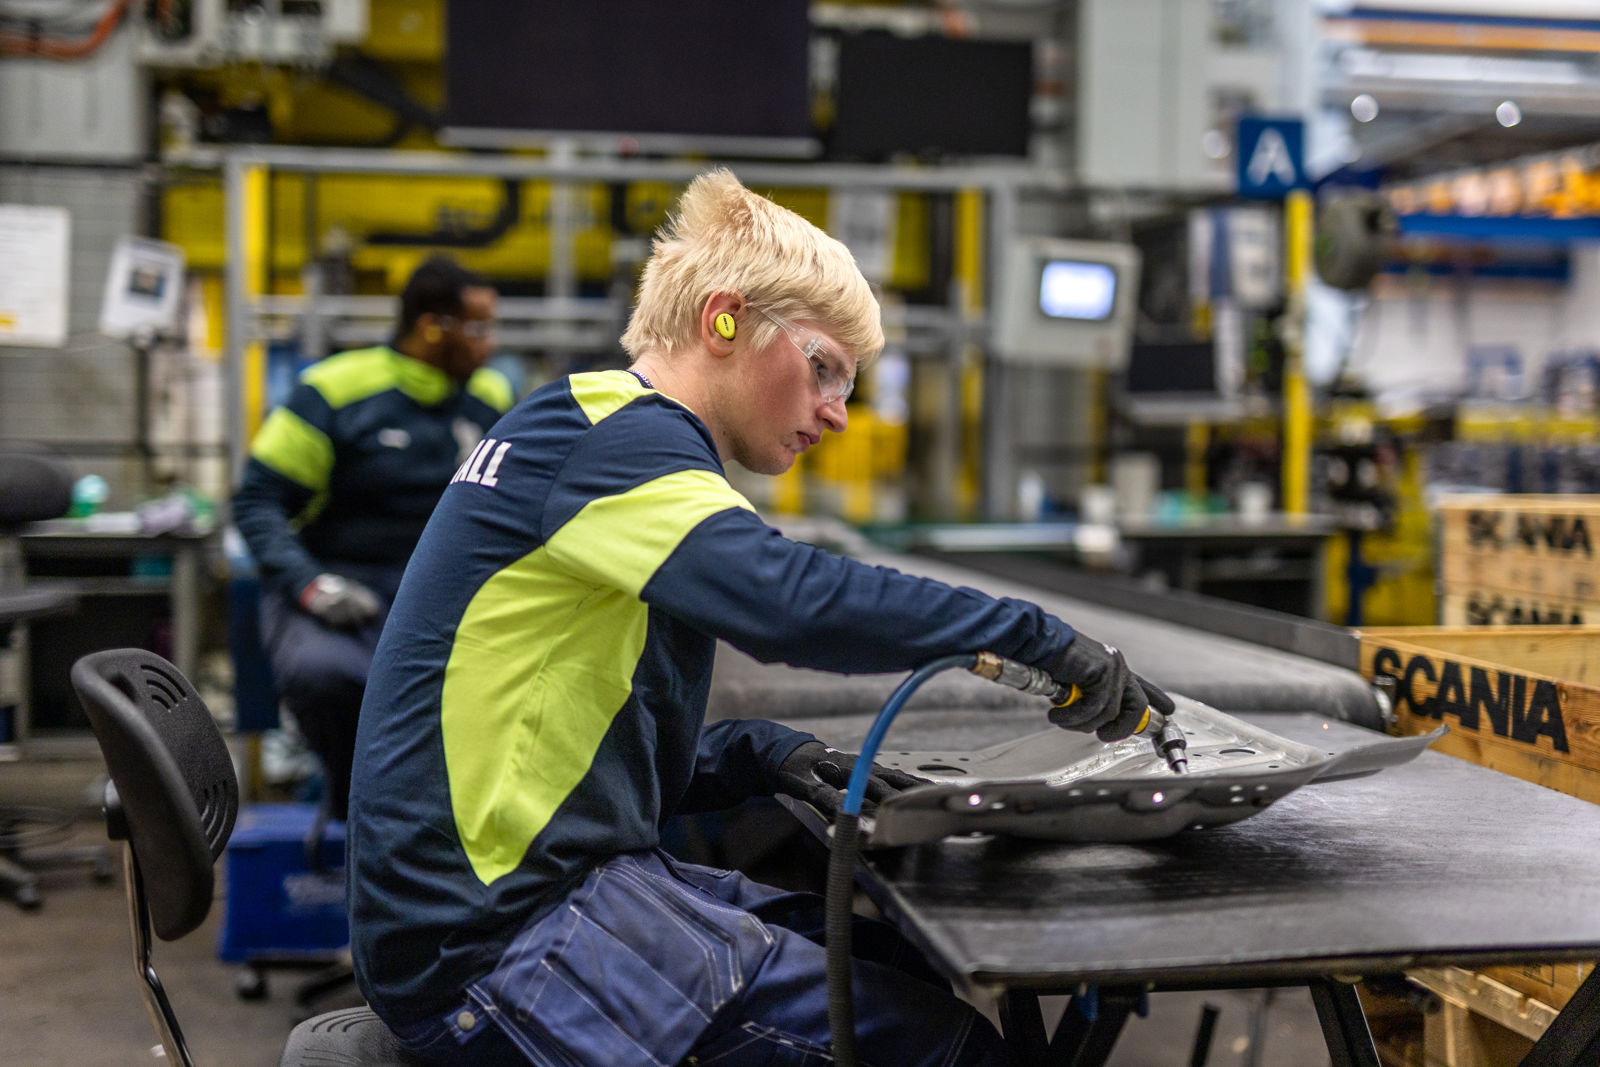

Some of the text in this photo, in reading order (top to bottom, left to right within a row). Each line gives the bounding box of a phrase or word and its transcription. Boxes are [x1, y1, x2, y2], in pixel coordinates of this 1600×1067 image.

[1247, 128, 1296, 187] A
[450, 438, 512, 488] ALL
[1373, 646, 1571, 755] SCANIA
